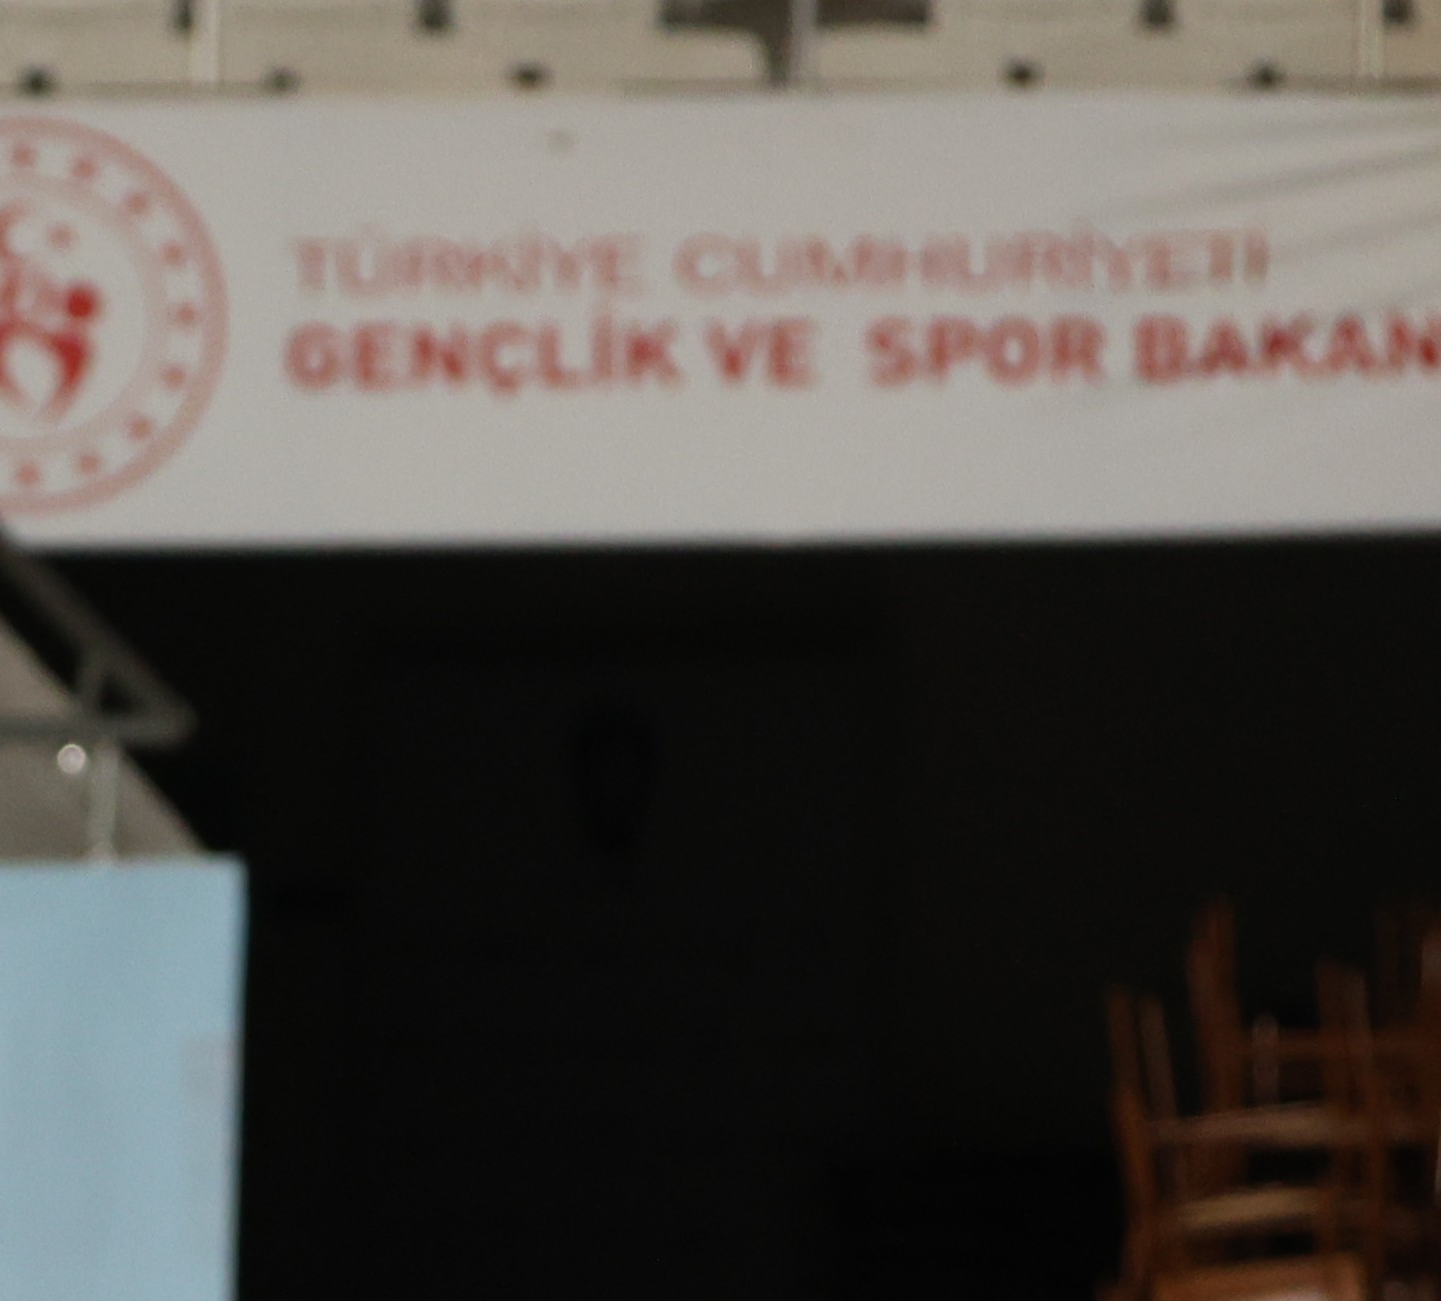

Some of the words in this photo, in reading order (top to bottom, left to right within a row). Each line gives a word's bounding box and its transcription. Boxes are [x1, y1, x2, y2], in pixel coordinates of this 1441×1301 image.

[285, 303, 681, 400] GENÇLİK
[703, 315, 817, 390] VE
[866, 313, 1105, 388] SPOR
